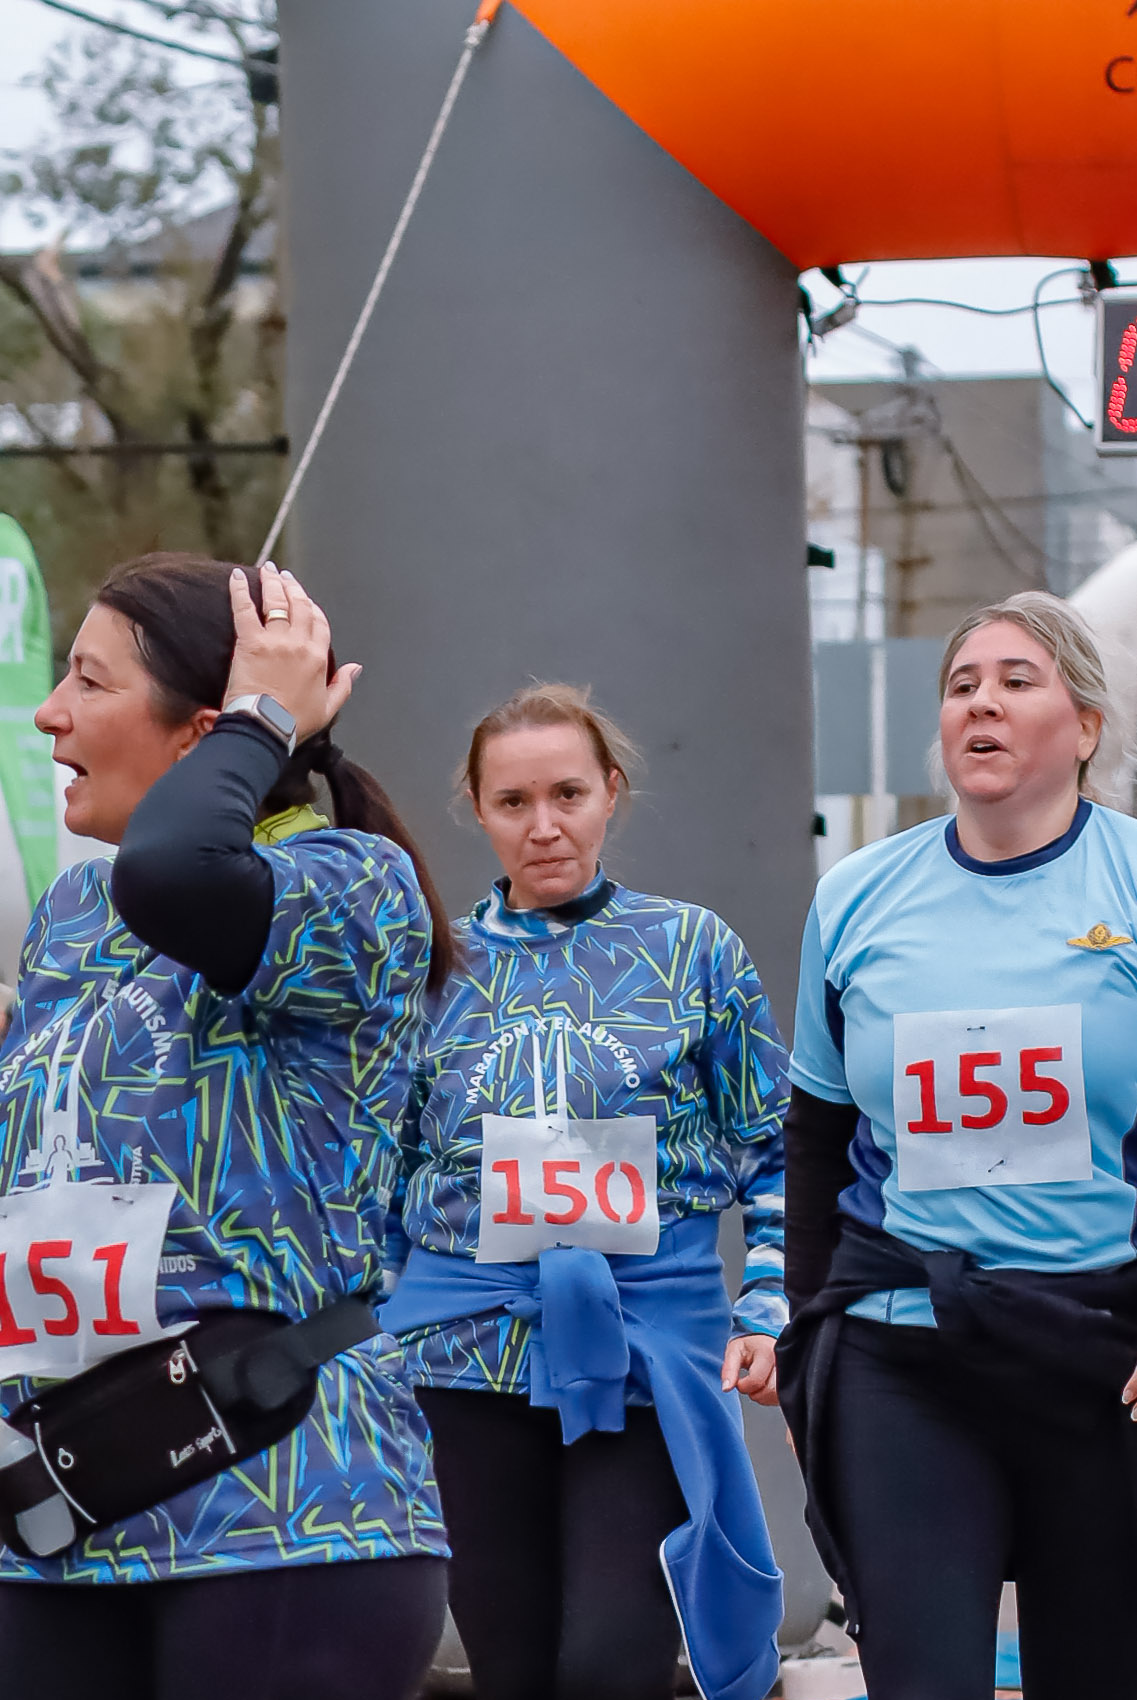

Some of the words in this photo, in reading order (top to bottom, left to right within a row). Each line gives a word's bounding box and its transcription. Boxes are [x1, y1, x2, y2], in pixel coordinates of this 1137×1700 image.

[534, 1017, 548, 1032] X
[554, 1016, 574, 1032] EL
[578, 1022, 641, 1089] AUTISMO
[905, 1046, 1070, 1134] 155
[491, 1159, 647, 1225] 150
